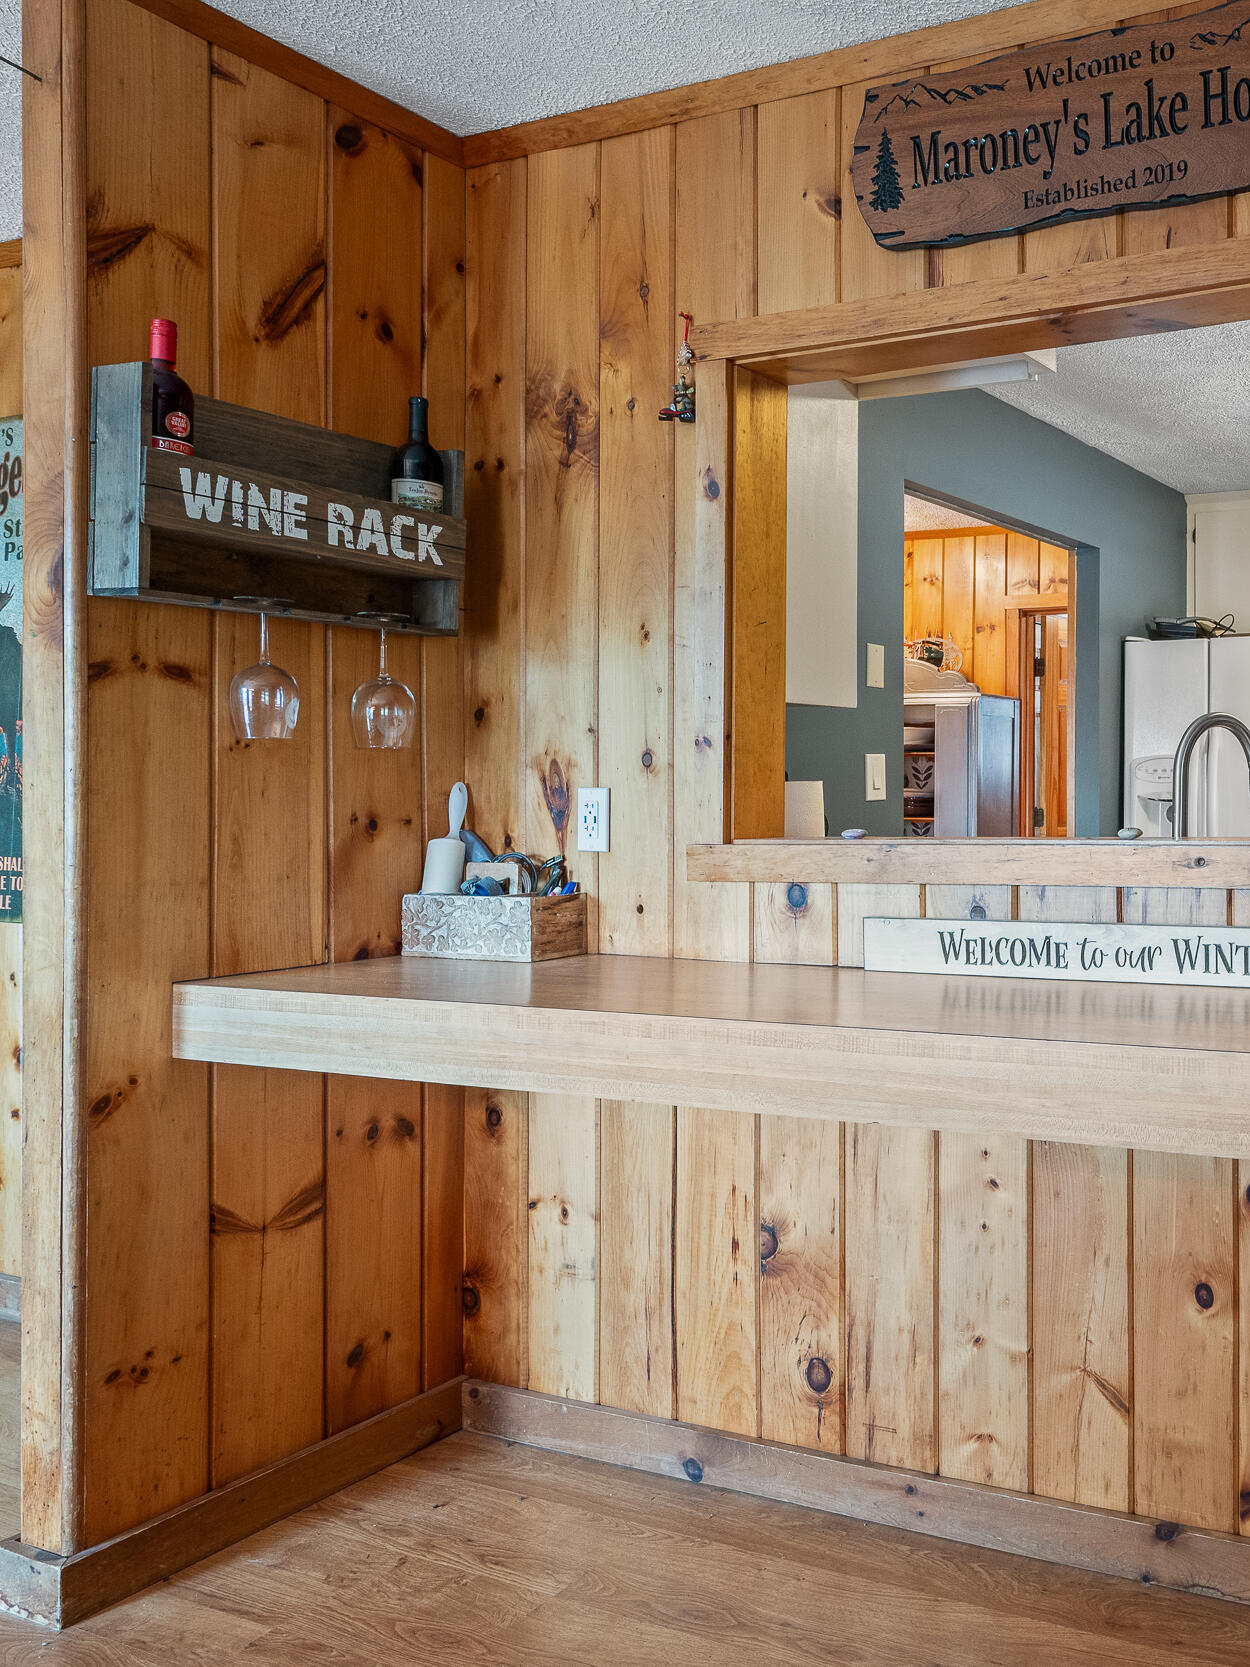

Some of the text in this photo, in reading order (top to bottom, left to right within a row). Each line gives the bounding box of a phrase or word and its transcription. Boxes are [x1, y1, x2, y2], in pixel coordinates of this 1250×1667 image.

[1022, 38, 1176, 93] Welcome to
[911, 98, 1091, 190] Maroney's
[1100, 79, 1190, 151] Lake
[1021, 160, 1190, 210] Established 2019
[179, 467, 444, 566] WINE RACK
[937, 928, 1069, 969] WELCOME
[1076, 937, 1109, 971] to
[1114, 945, 1162, 973] our
